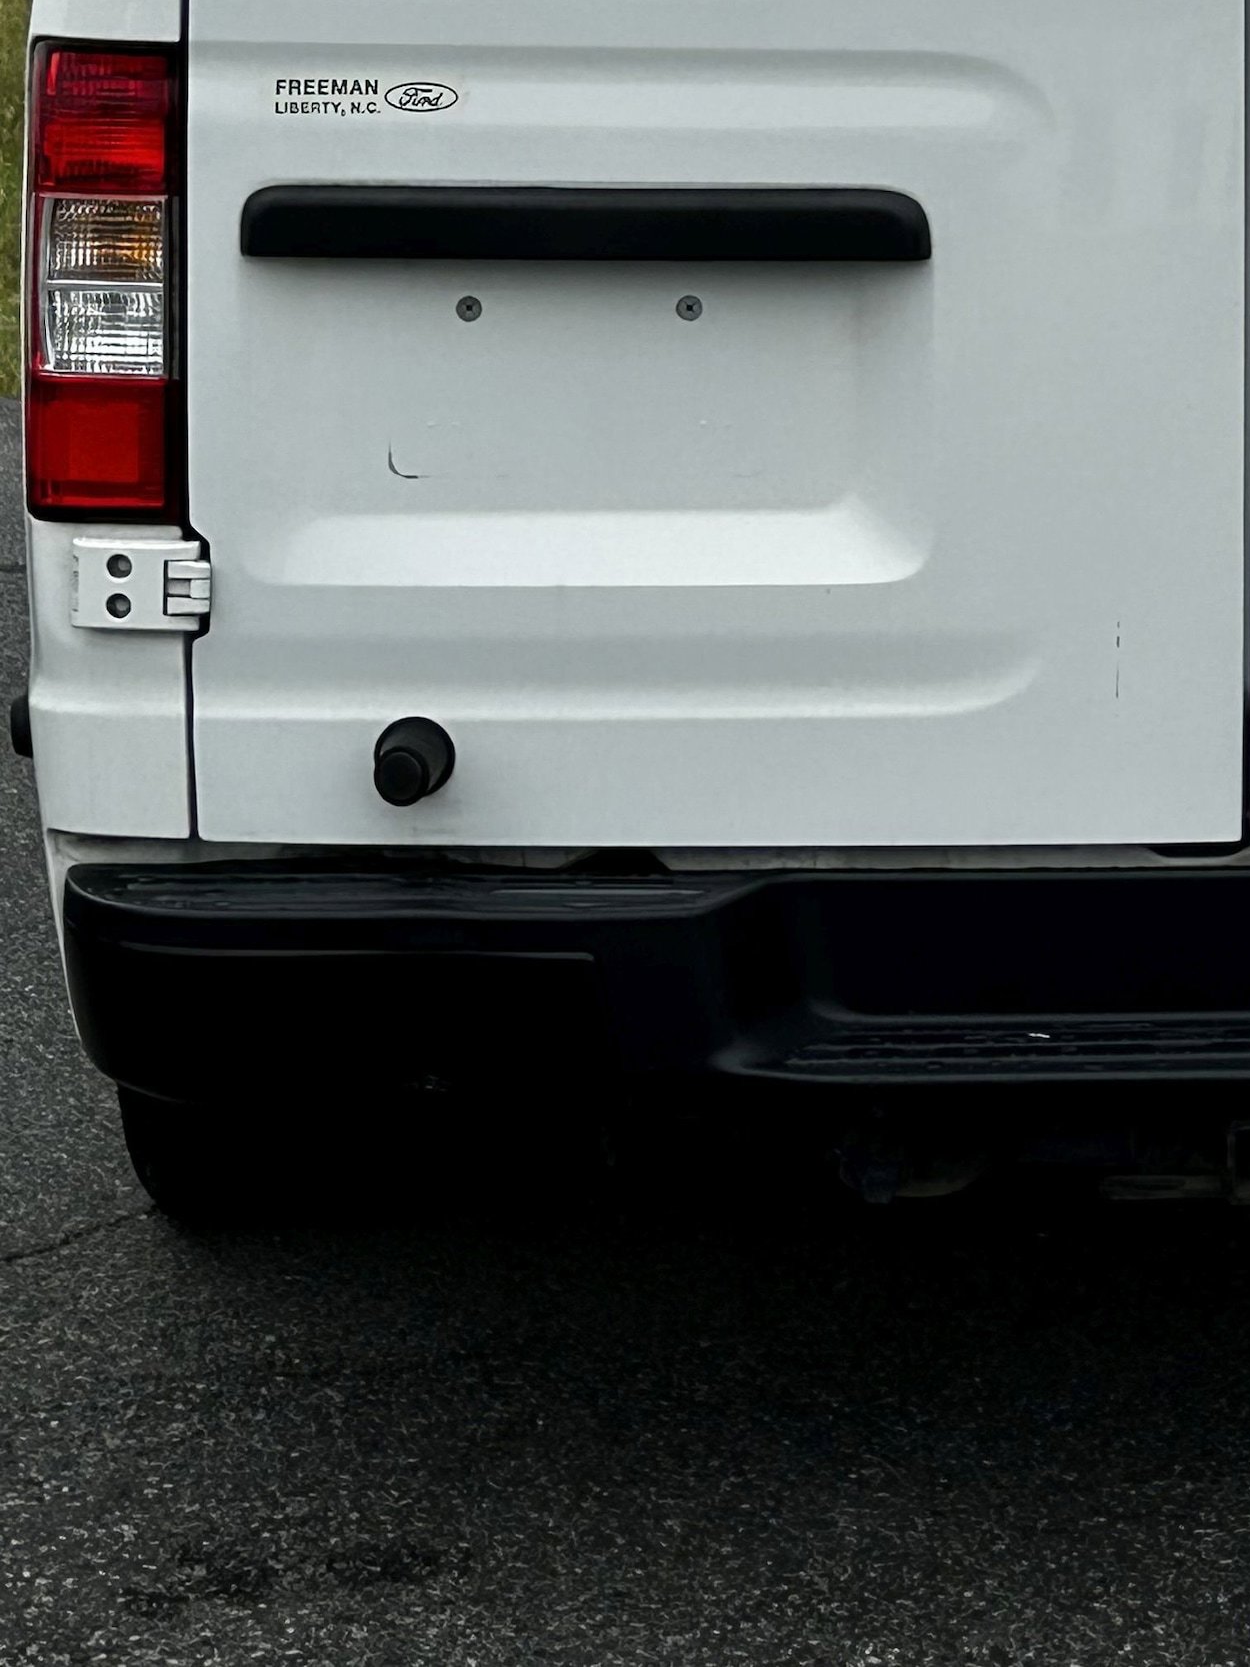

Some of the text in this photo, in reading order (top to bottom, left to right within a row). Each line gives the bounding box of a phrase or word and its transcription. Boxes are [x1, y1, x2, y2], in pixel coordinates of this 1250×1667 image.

[275, 79, 379, 95] FREEMAN
[398, 87, 443, 107] Ford
[275, 101, 381, 116] LIBERTY, N.C.
